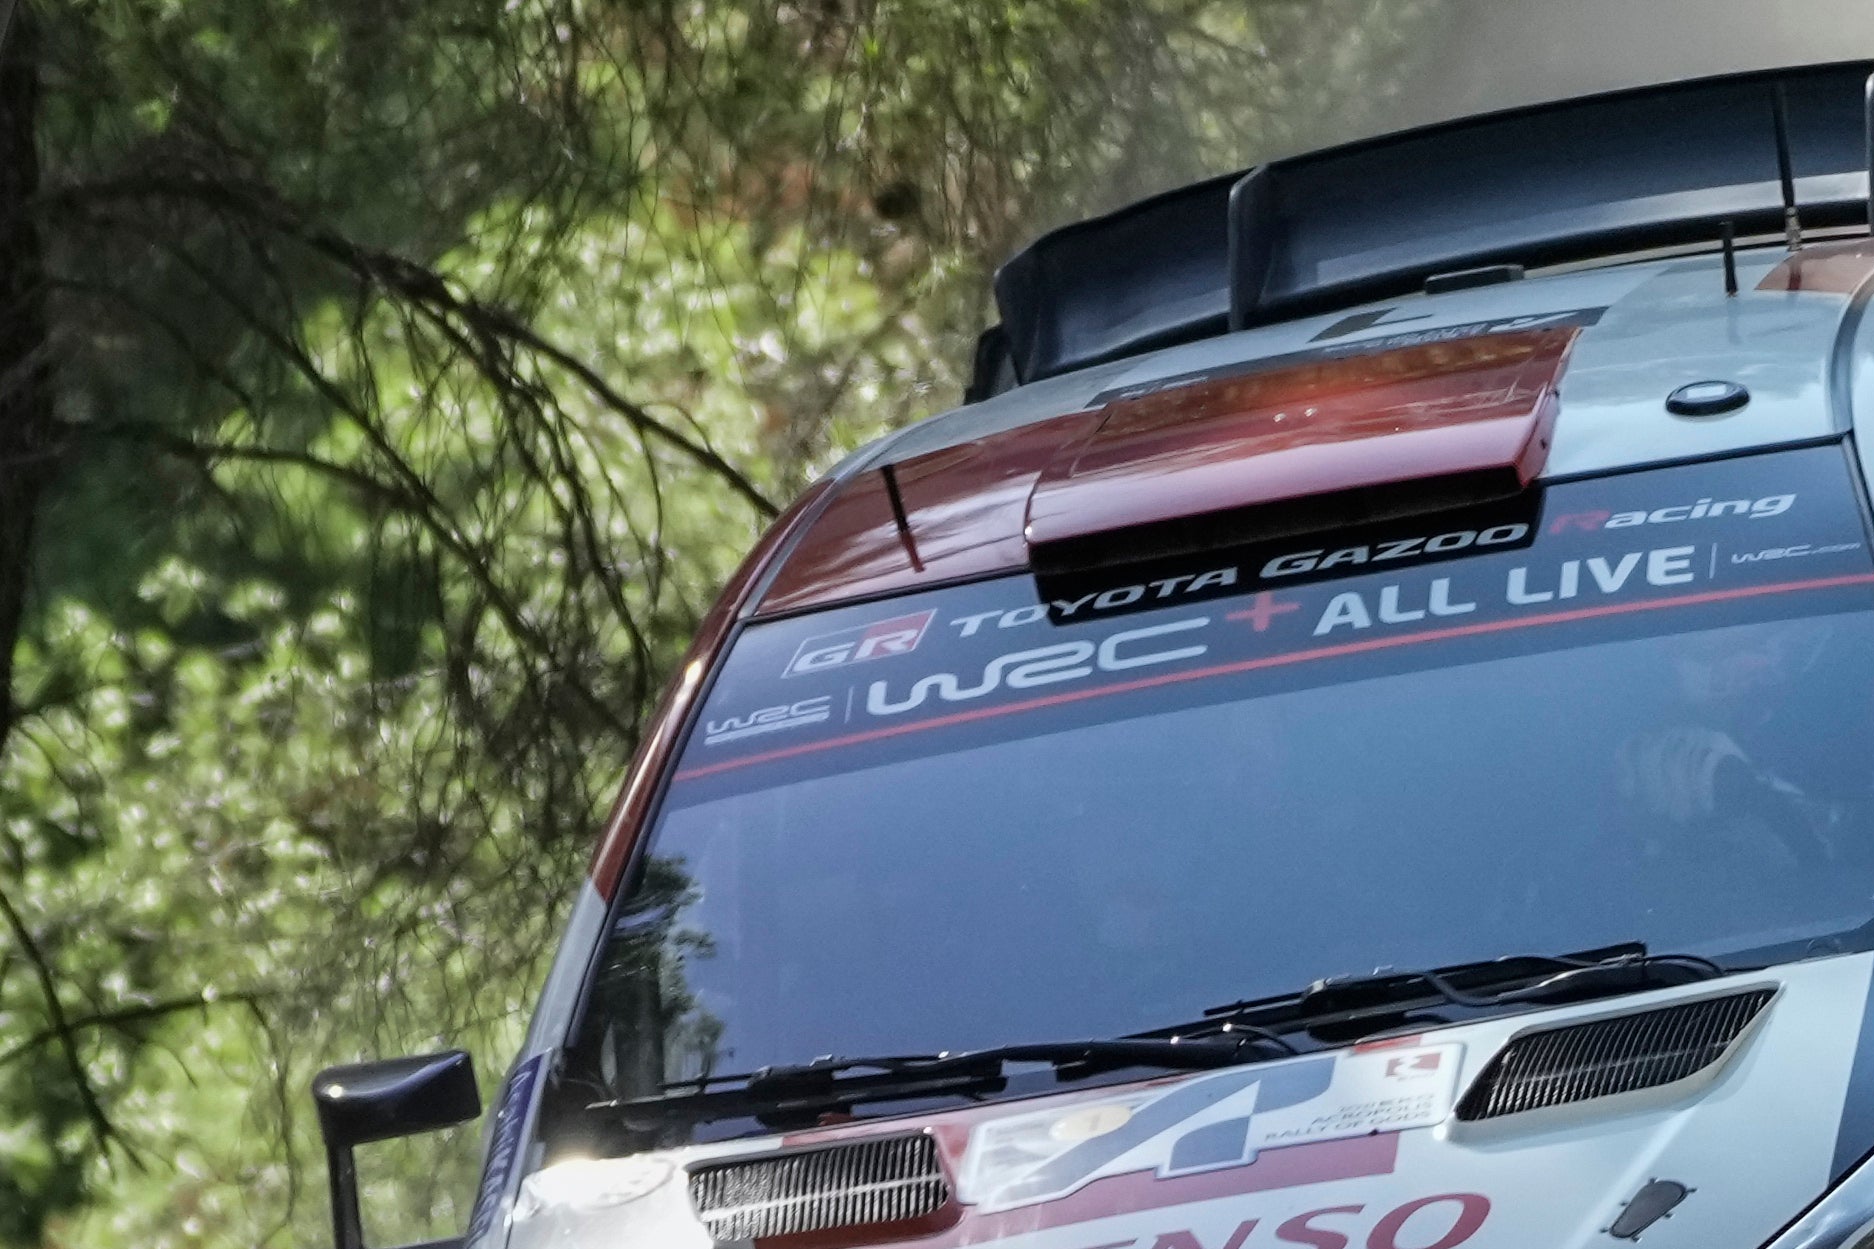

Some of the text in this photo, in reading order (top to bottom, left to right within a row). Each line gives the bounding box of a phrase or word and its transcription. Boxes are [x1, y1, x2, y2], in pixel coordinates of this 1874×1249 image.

[950, 492, 1797, 638] TOYOTA GAZOO Racing
[1313, 577, 1475, 636] ALL
[1506, 545, 1694, 607] LIVE
[795, 627, 921, 673] GR
[705, 696, 831, 741] WRC
